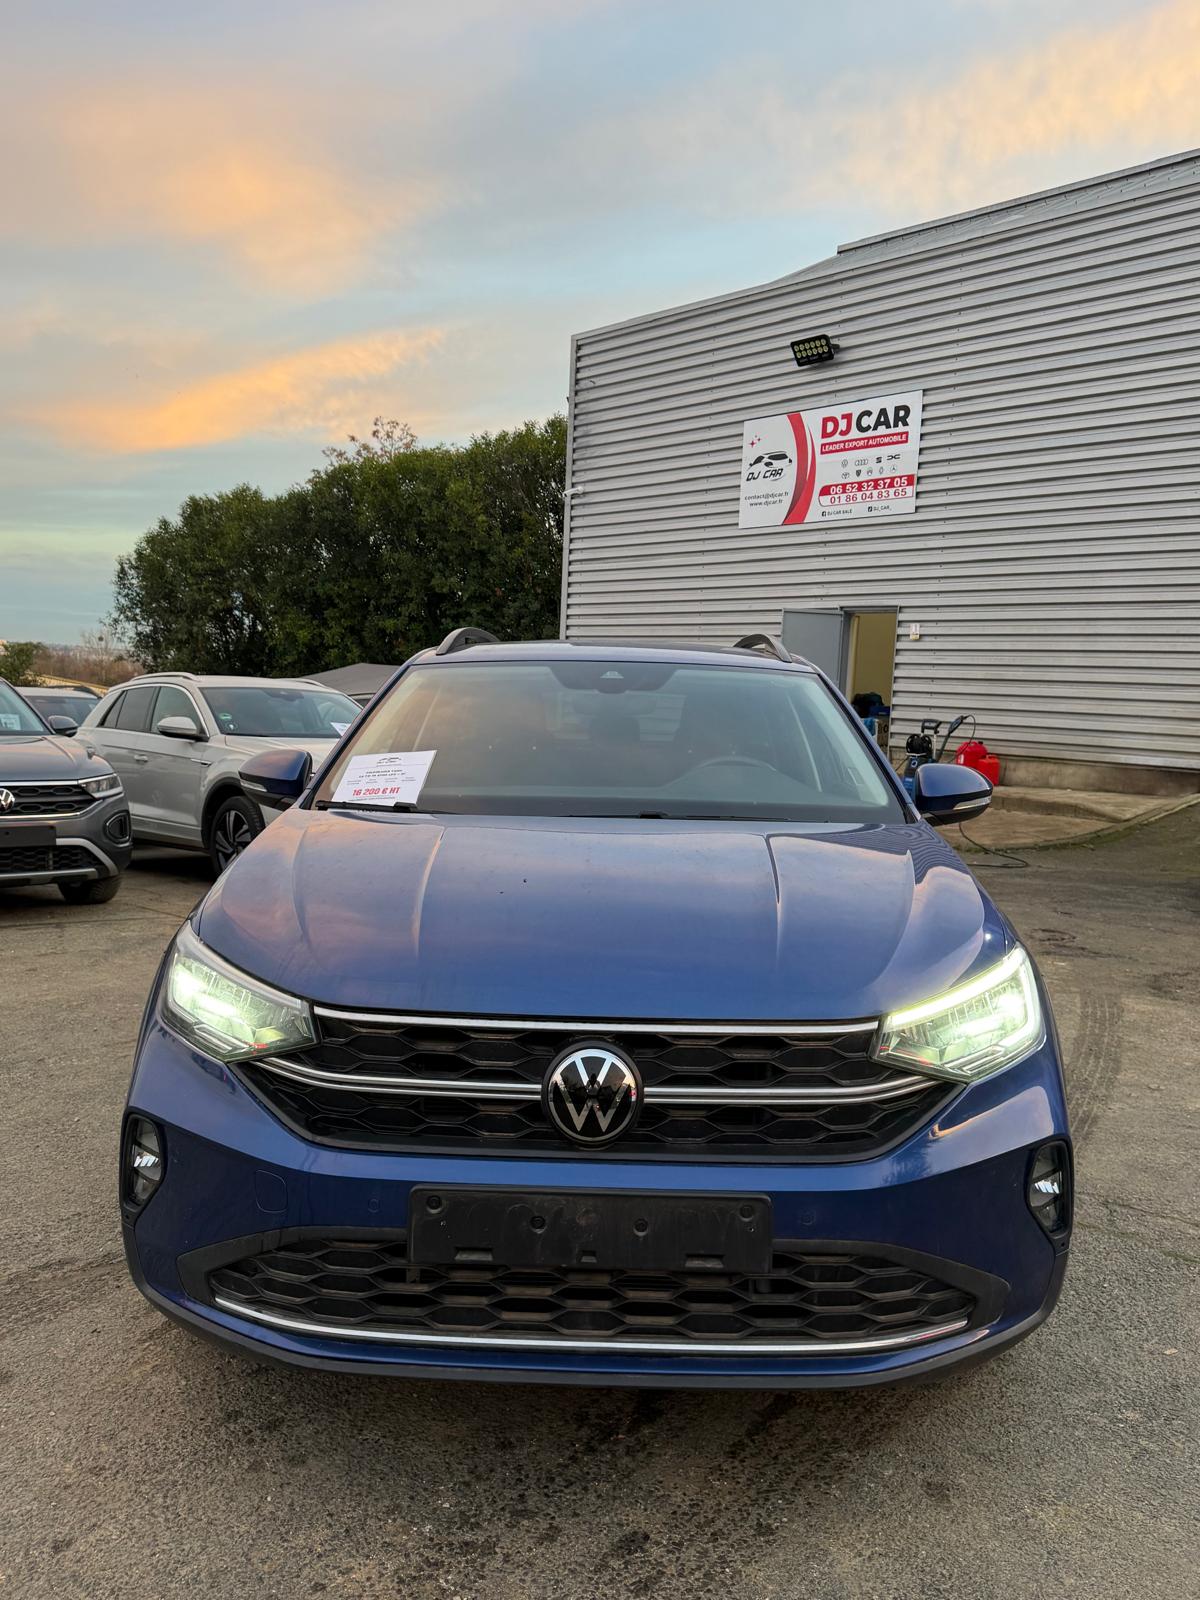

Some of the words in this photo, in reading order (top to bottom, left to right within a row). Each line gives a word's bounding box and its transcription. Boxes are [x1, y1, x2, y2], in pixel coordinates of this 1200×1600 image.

[821, 412, 853, 439] DJ
[856, 405, 911, 433] CAR
[822, 443, 844, 452] LEADER
[845, 440, 868, 449] EXPORT
[868, 435, 907, 445] AUTOMOBILE
[746, 471, 761, 482] DJ
[763, 468, 783, 479] CAR
[830, 486, 843, 495] 06
[845, 484, 858, 493] 52
[861, 481, 874, 491] 32
[877, 479, 891, 489] 37
[893, 477, 908, 487] 05
[744, 491, 789, 501] contact@djcar.fr
[830, 496, 841, 505] 01
[845, 494, 858, 503] 86
[861, 492, 873, 501] 04
[877, 490, 890, 499] 83
[893, 488, 907, 497] 65
[352, 788, 362, 796] 16
[363, 787, 381, 796] 200
[389, 786, 401, 795] HT
